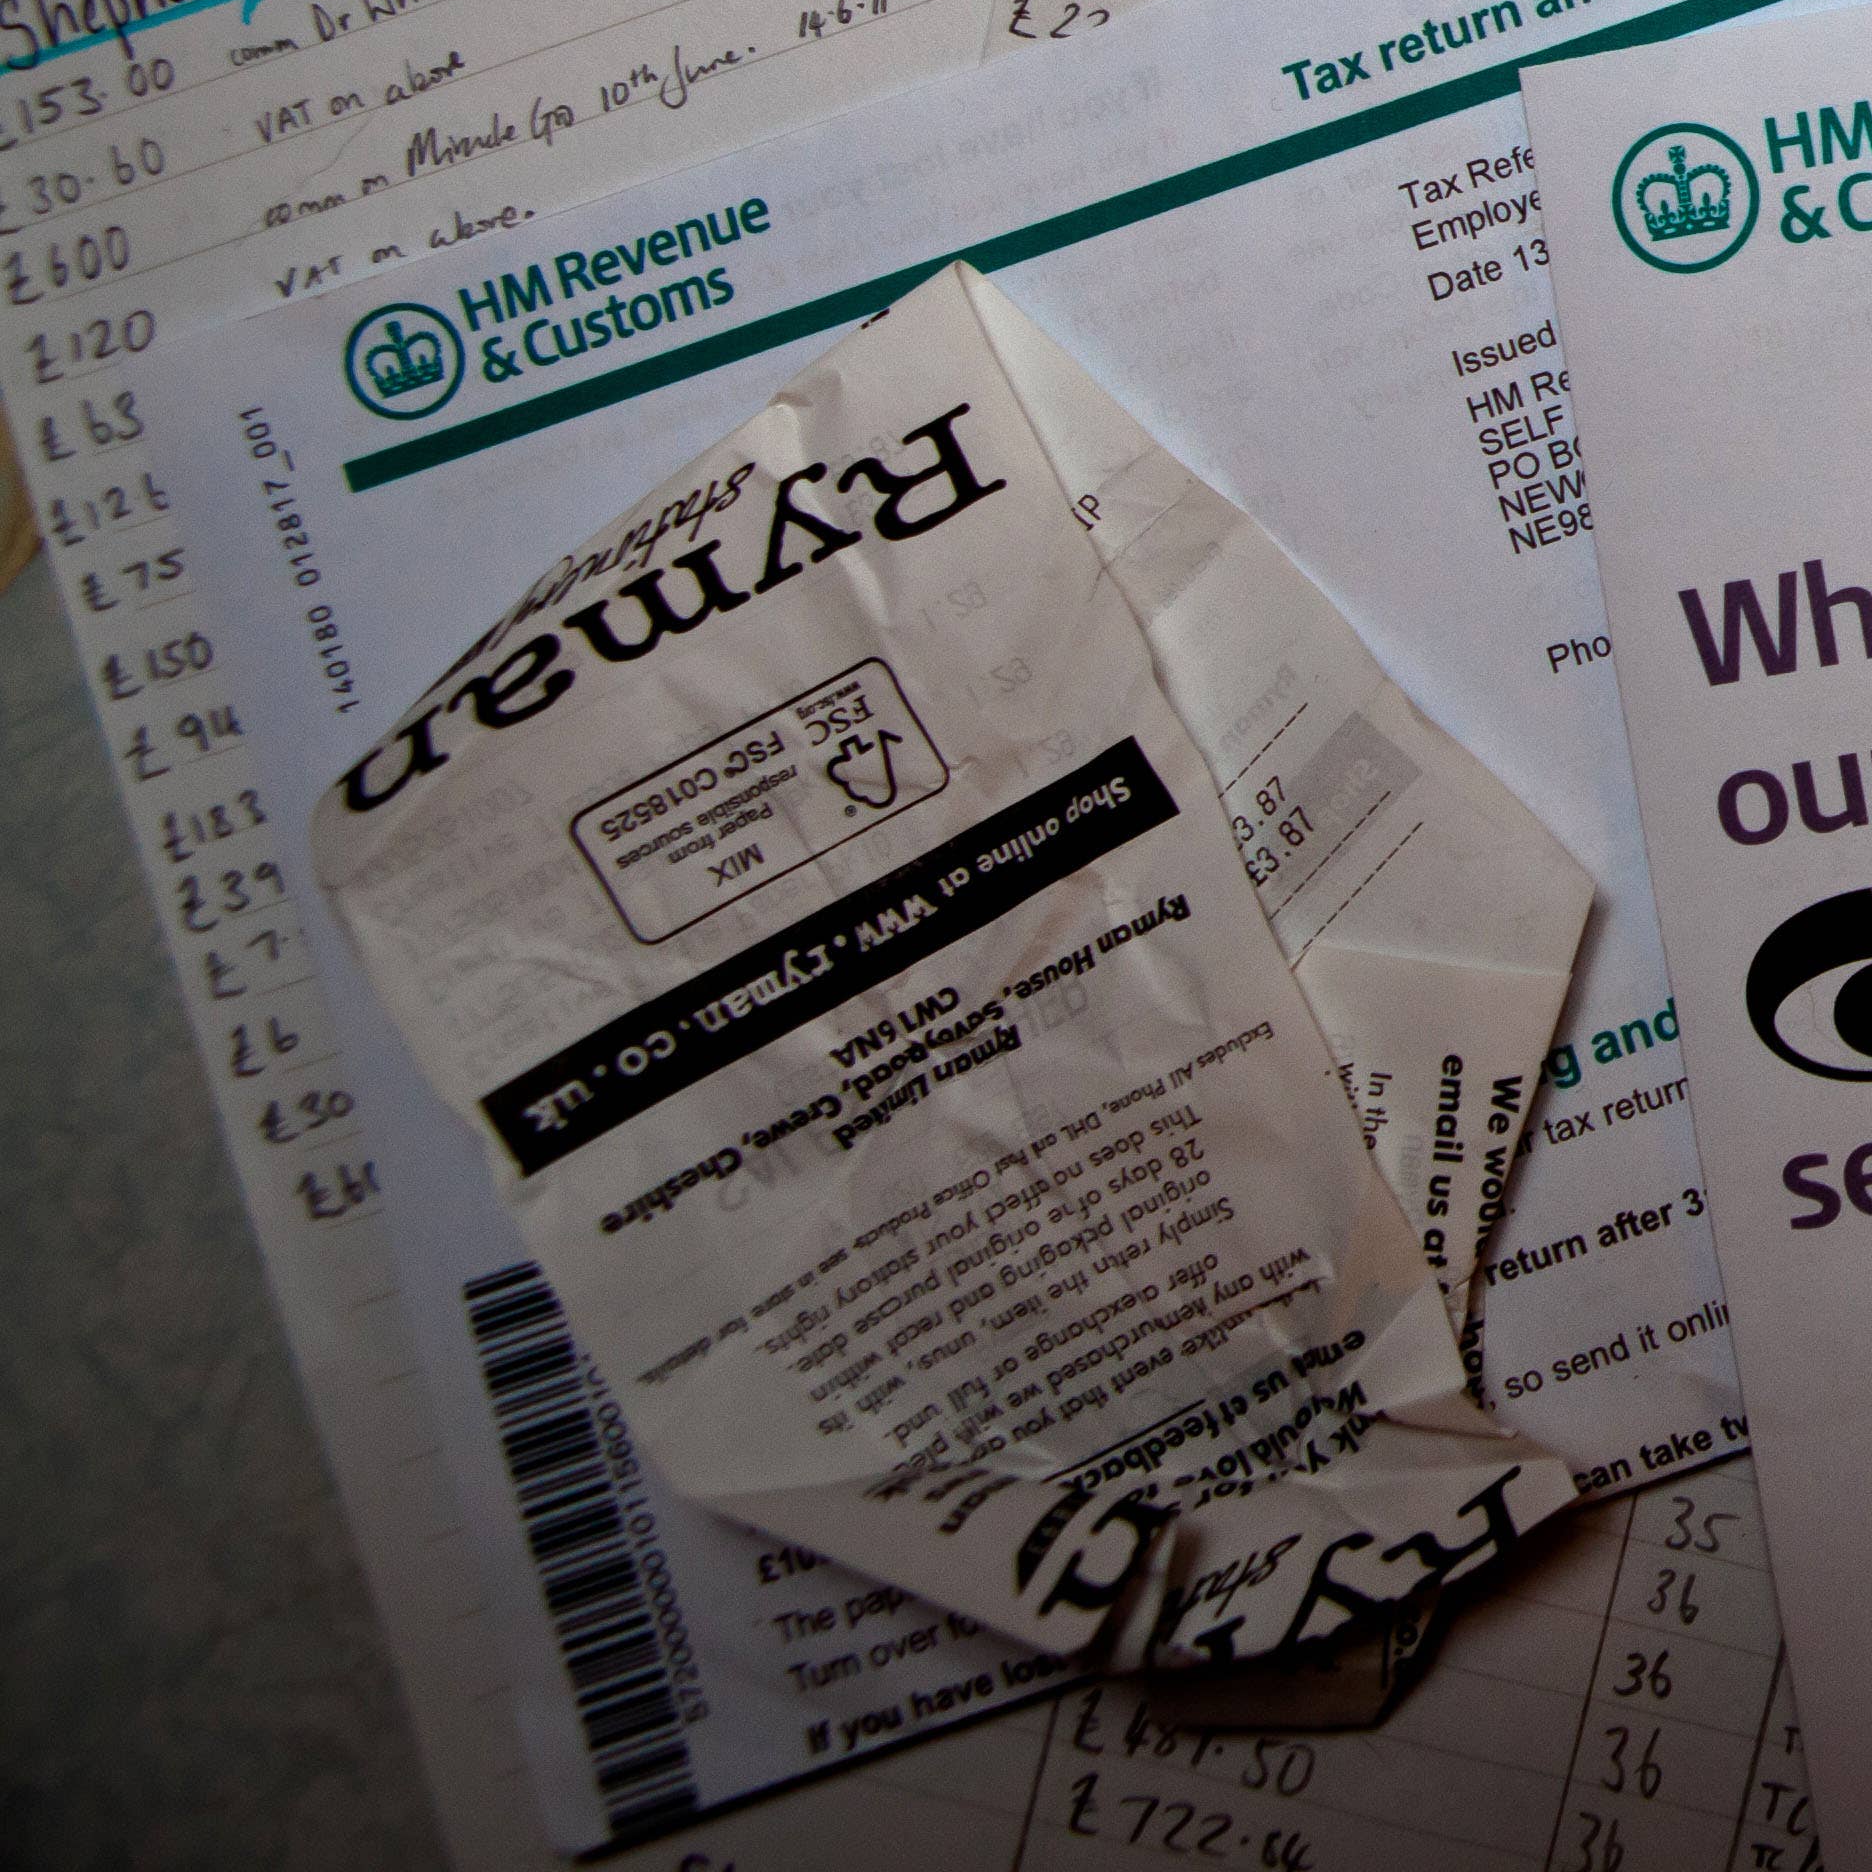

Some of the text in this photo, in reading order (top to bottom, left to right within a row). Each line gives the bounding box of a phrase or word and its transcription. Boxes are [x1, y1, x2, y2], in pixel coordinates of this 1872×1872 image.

[1281, 51, 1370, 100] Tax
[1378, 0, 1522, 71] return
[457, 198, 770, 331] HM Revenue
[1780, 184, 1831, 243] &
[481, 267, 734, 383] & Customs
[339, 402, 1007, 815] Ryman
[599, 767, 718, 842] C018525
[706, 843, 764, 887] MIX
[521, 773, 1133, 1137] Shop online at www.ryman.co.uk
